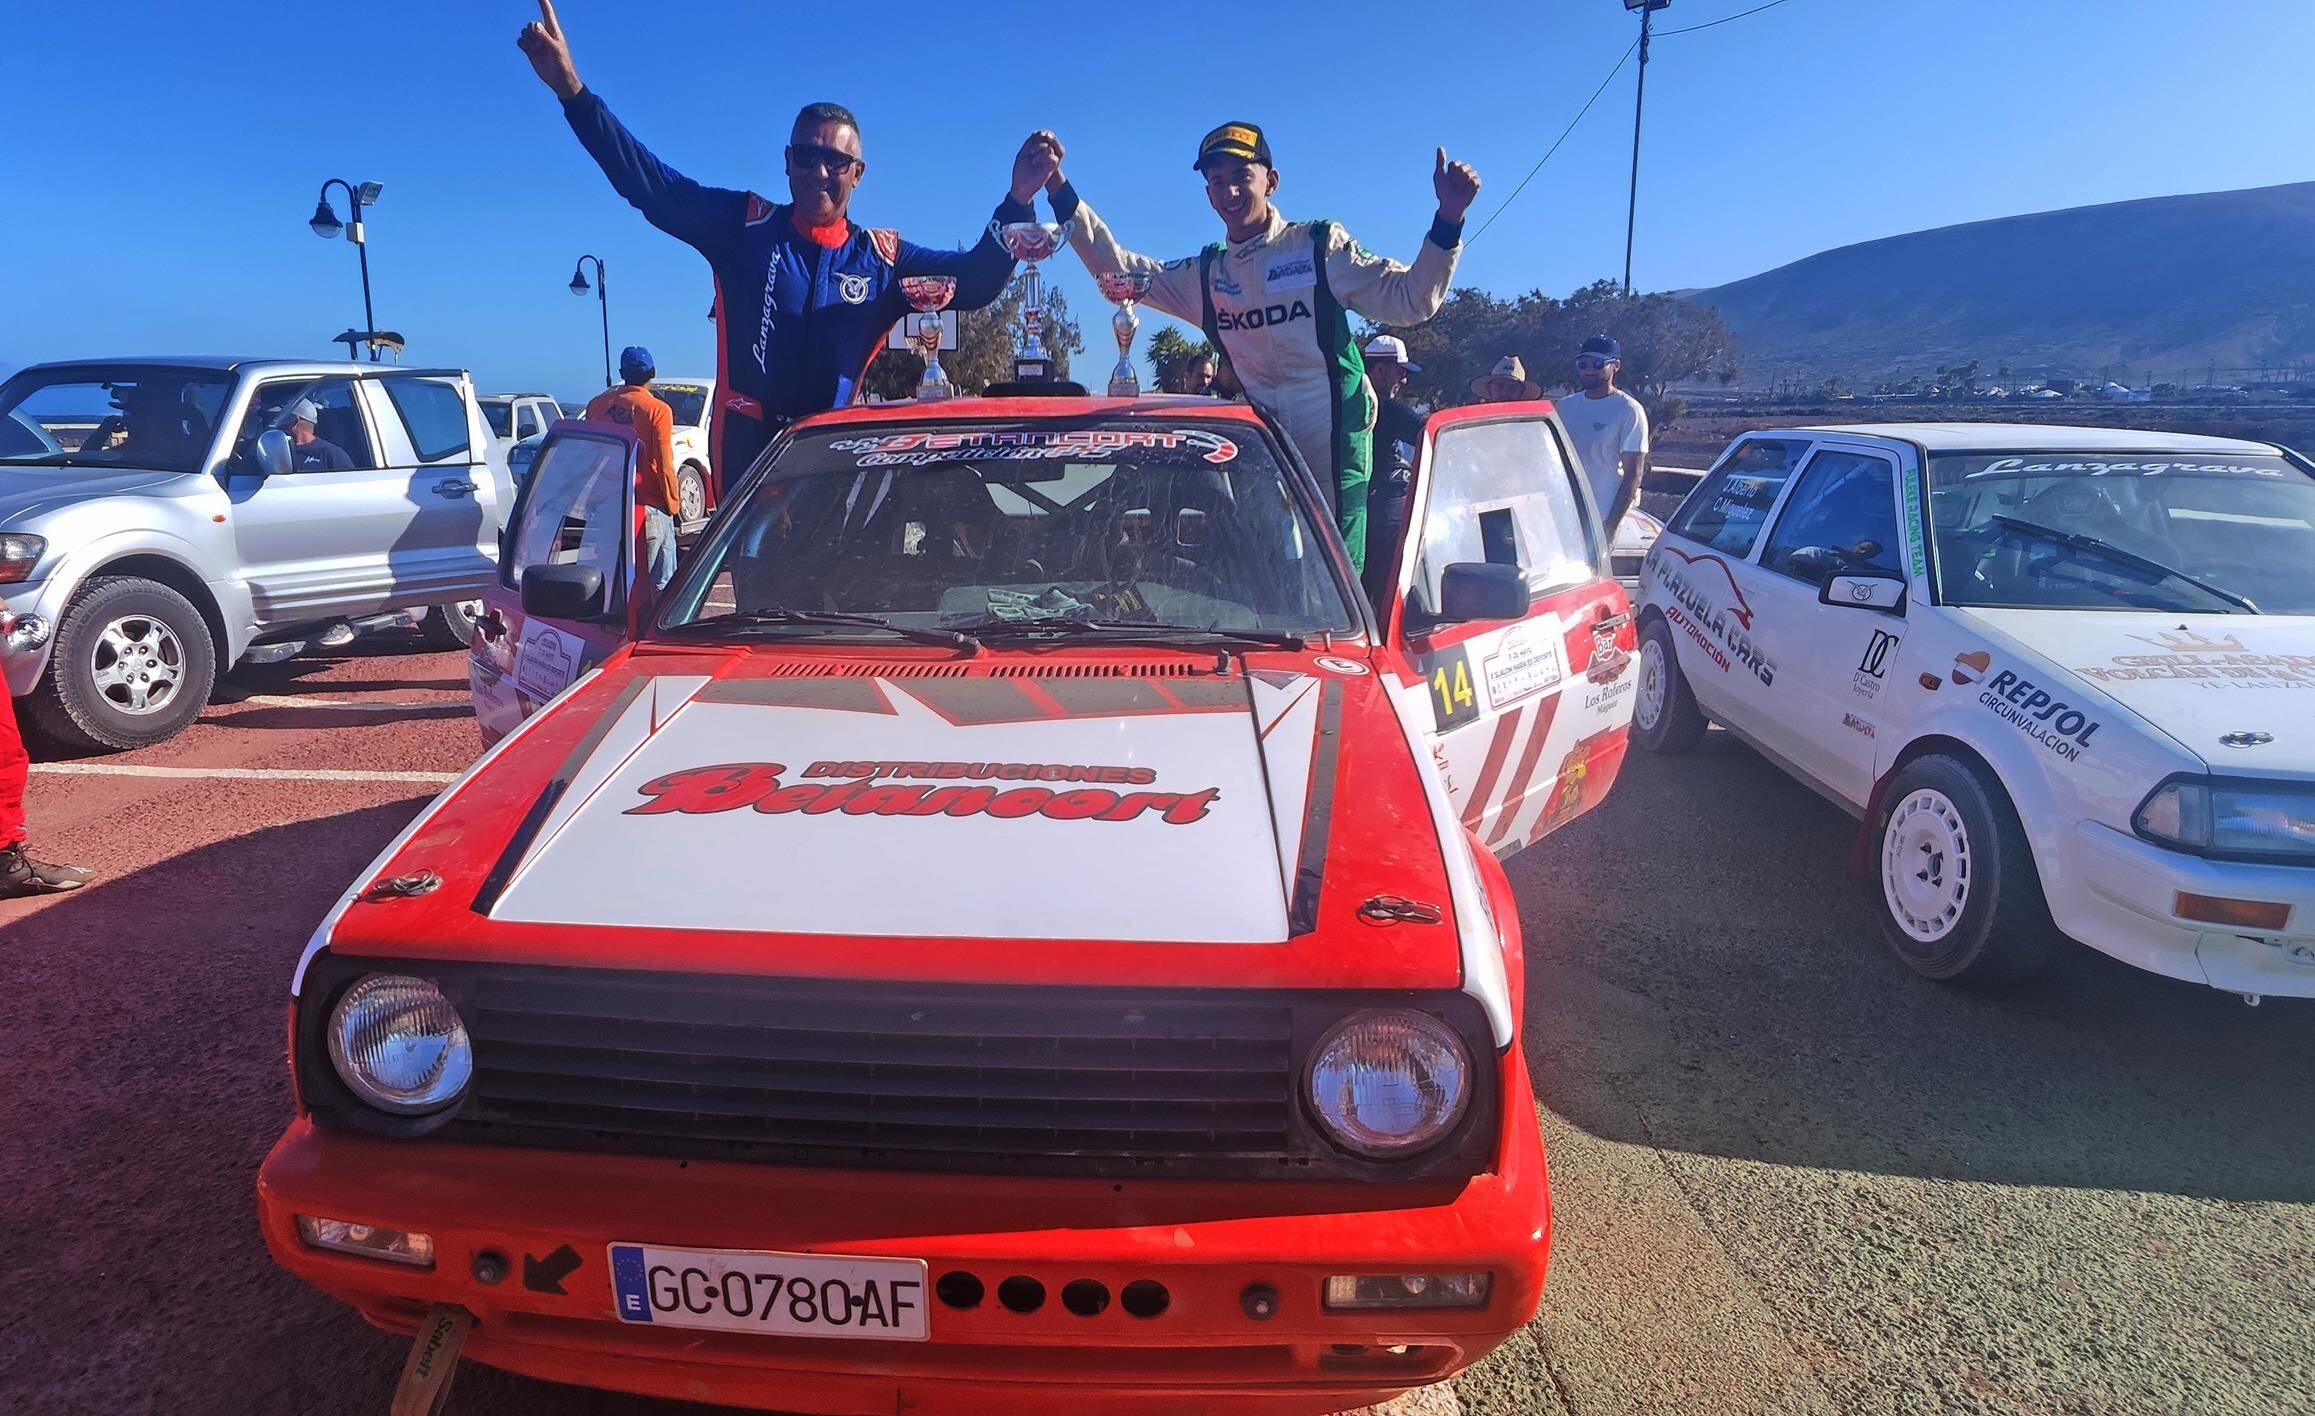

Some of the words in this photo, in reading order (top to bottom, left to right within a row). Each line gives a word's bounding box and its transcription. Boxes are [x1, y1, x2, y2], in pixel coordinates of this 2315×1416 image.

[752, 242, 782, 375] Lanzagrava
[1965, 458, 2284, 479] Lanzagrava
[1908, 505, 1921, 543] RACING
[1911, 543, 1924, 578] TEAM
[1657, 561, 1727, 639] PLAZUELA
[1727, 623, 1778, 687] CARS
[1597, 635, 1613, 655] Bar
[1433, 659, 1473, 716] 14
[1584, 693, 1601, 710] Los
[1978, 691, 2080, 763] CIRCUNVALACION
[1988, 669, 2101, 749] REPSOL
[800, 761, 1157, 784] DISTRIBUCIONES
[622, 763, 1222, 825] Betancort
[625, 1294, 641, 1312] E
